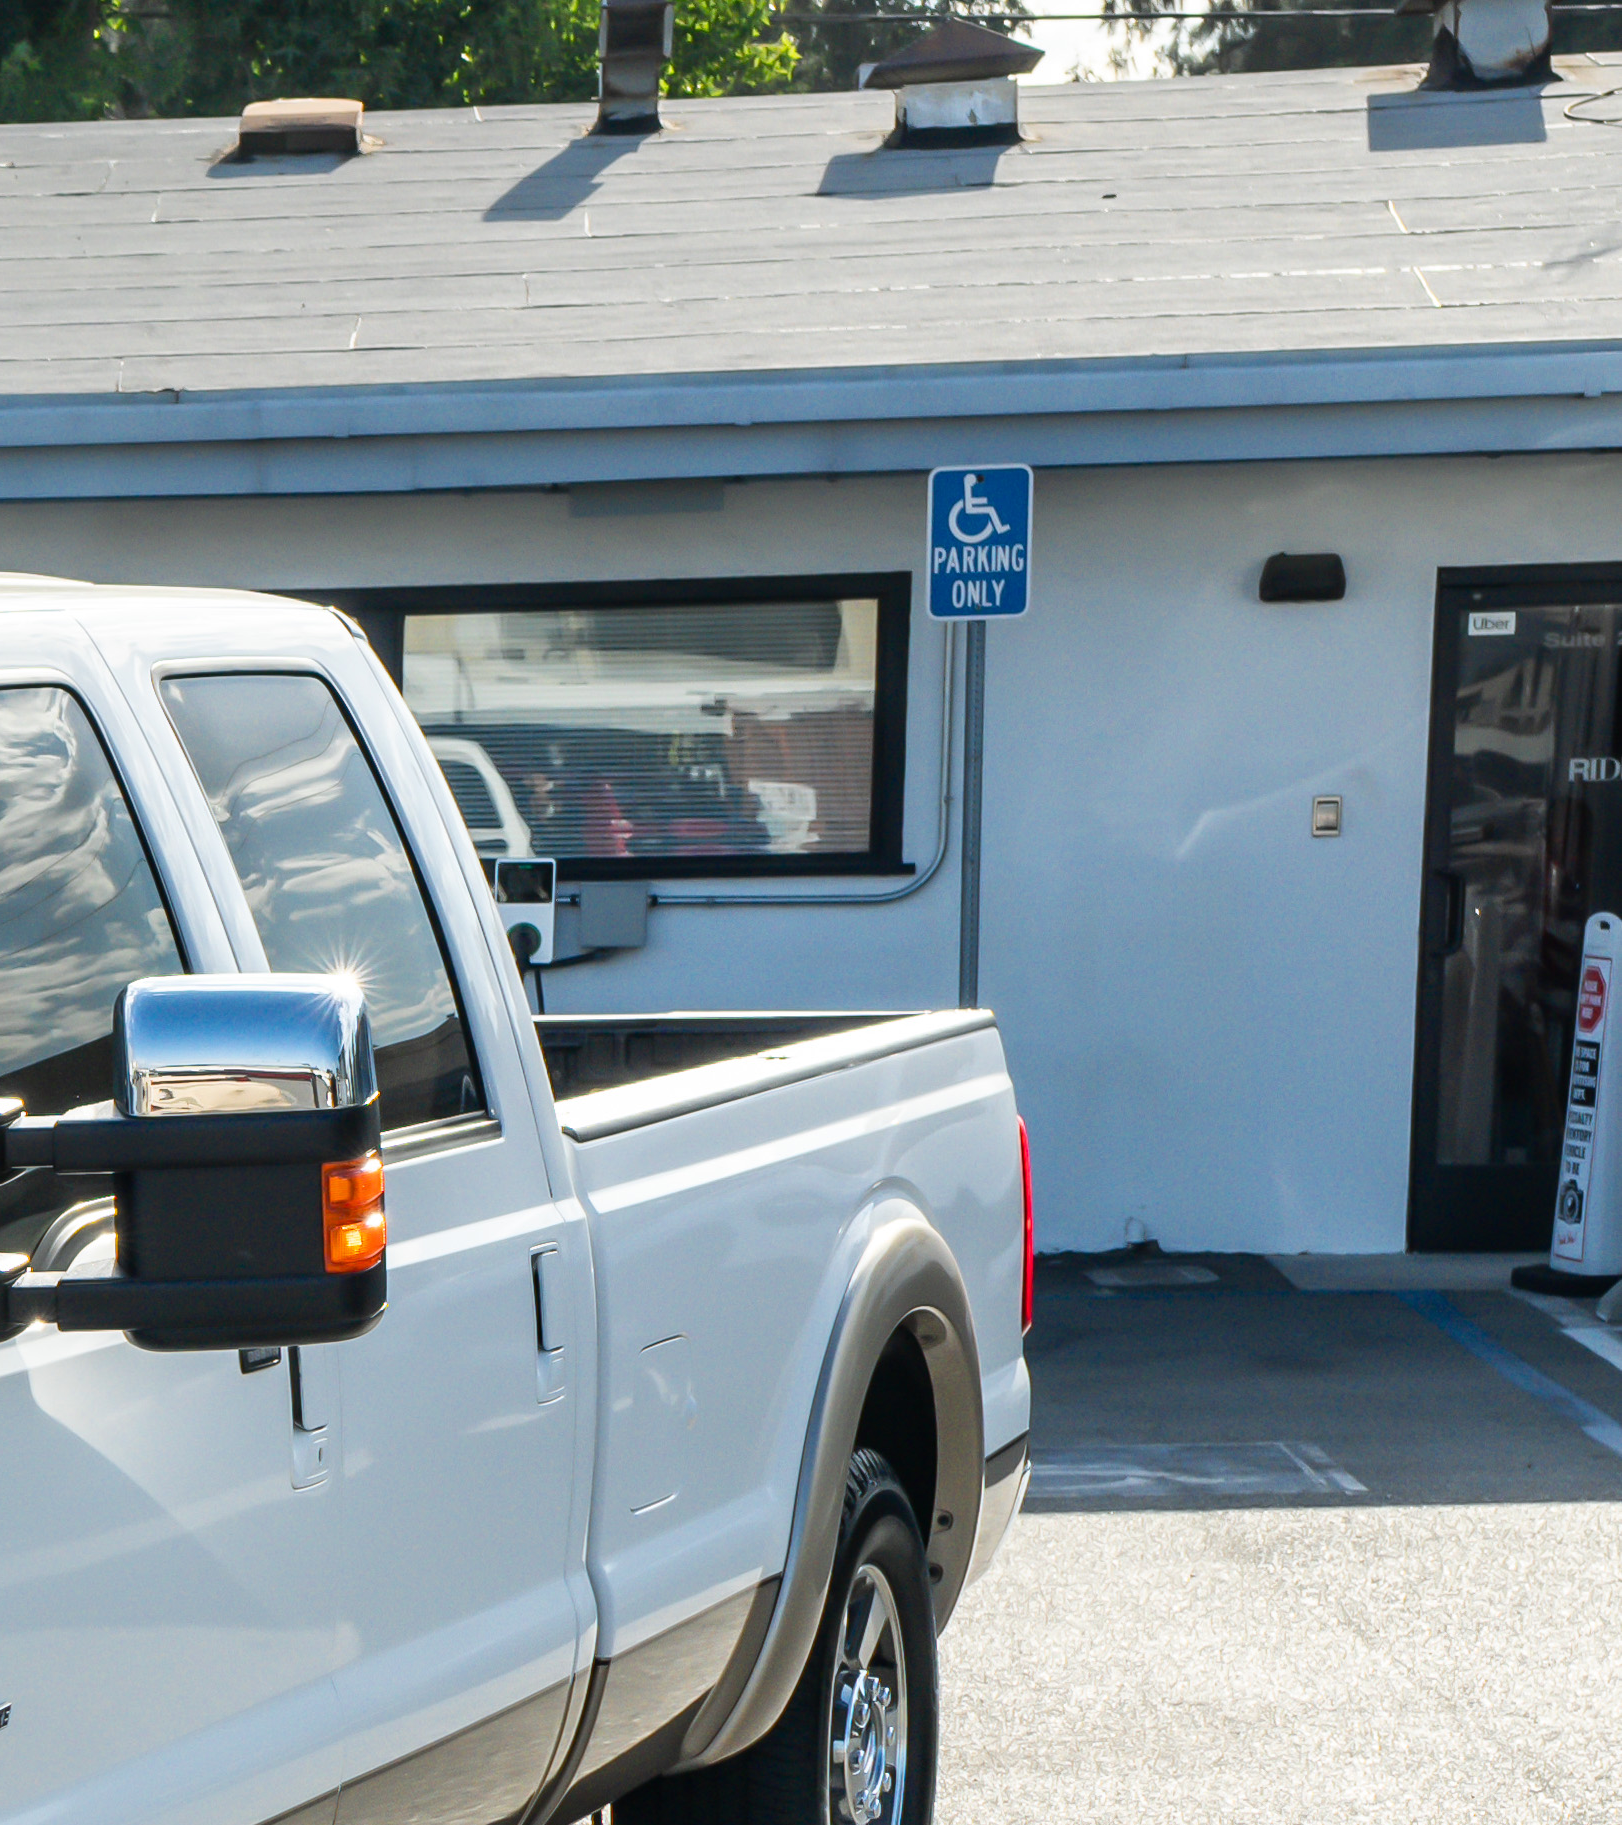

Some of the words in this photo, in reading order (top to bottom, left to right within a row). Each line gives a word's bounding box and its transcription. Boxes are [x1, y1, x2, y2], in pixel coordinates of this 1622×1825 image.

[933, 543, 1025, 574] PARKING
[951, 579, 1006, 608] ONLY
[1473, 617, 1510, 631] Uber
[1544, 631, 1606, 648] Suite
[1568, 757, 1622, 782] RID
